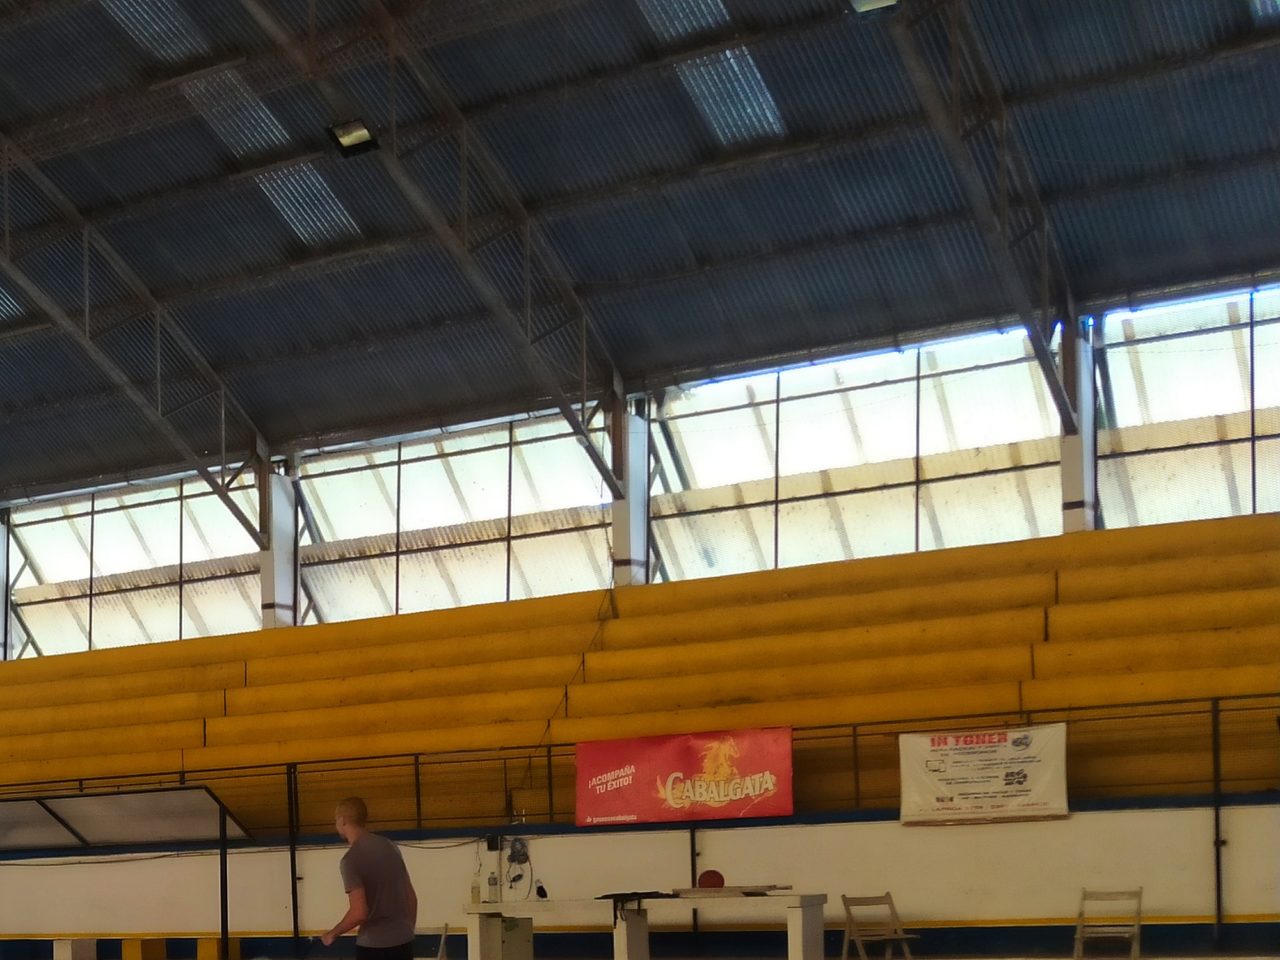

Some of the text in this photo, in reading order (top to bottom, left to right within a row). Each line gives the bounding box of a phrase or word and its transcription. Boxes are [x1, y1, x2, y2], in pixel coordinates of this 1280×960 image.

[954, 732, 1008, 746] TONER
[596, 784, 606, 794] TU
[665, 770, 775, 808] CABALGATA
